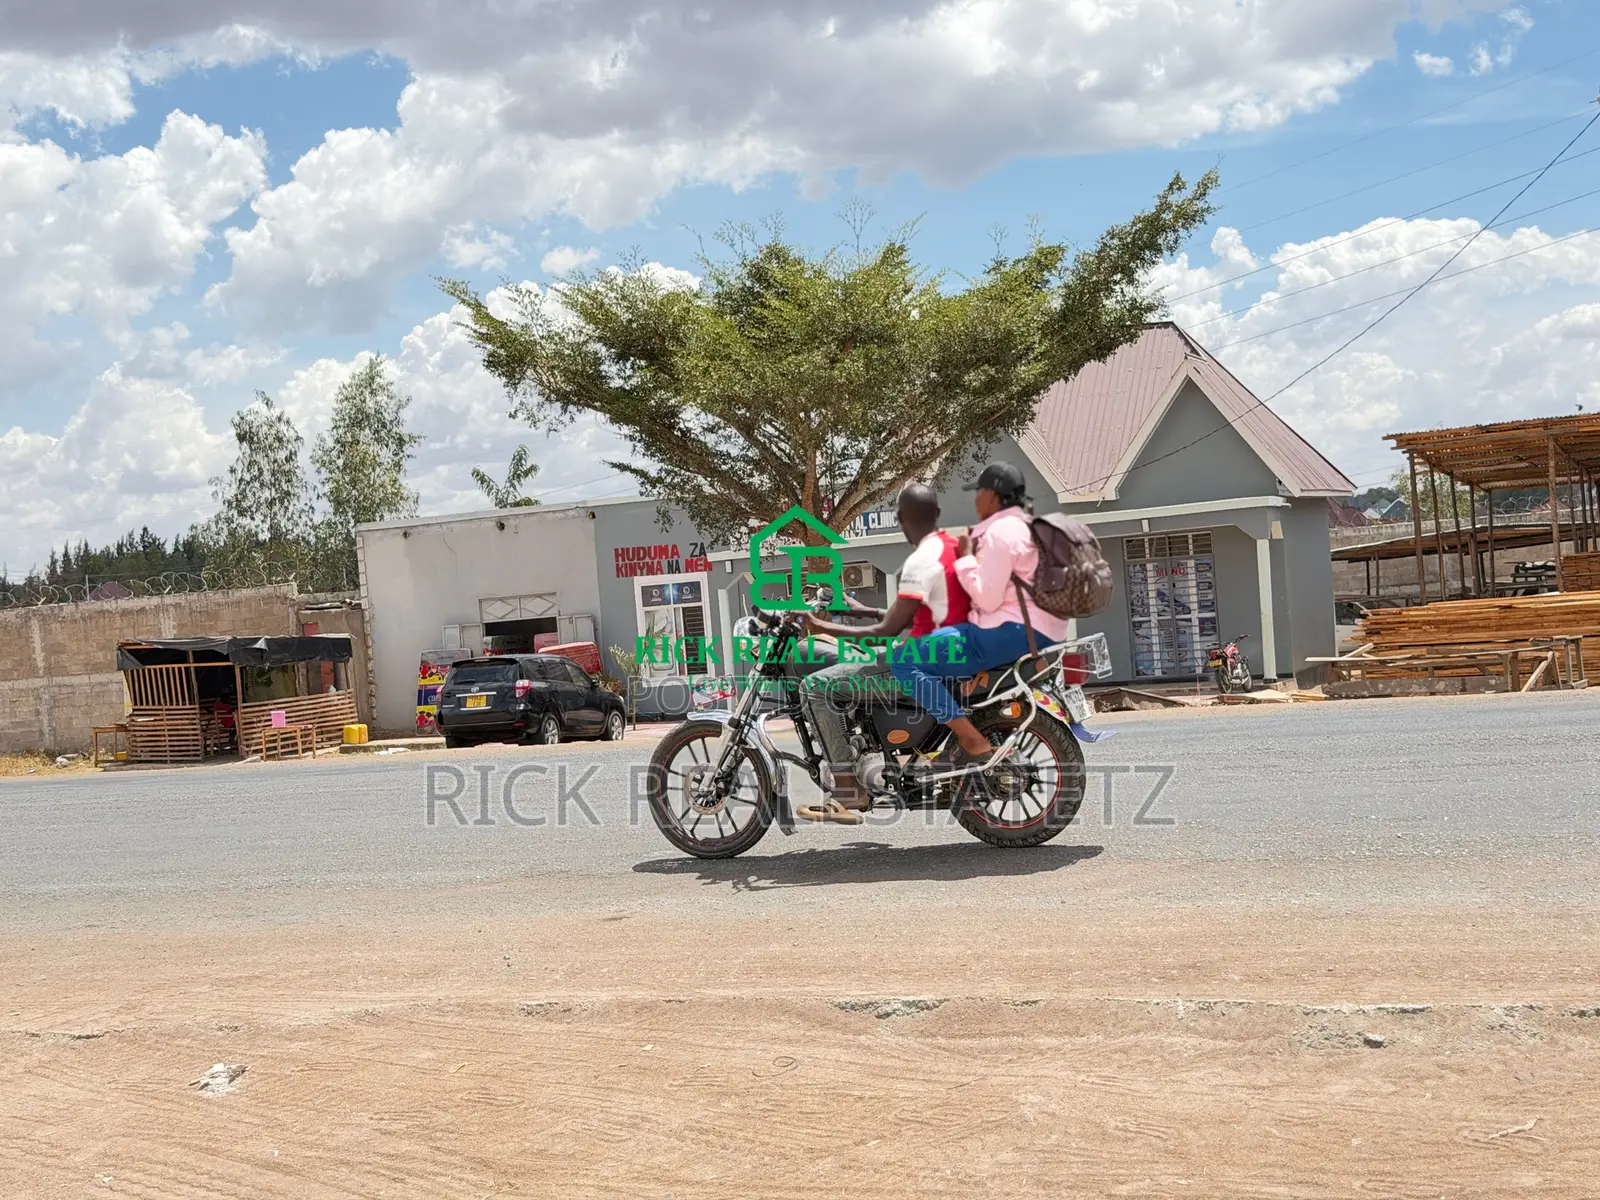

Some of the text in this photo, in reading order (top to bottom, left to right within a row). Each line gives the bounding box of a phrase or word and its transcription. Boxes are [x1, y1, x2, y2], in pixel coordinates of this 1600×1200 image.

[868, 511, 898, 529] CLINIC
[614, 542, 707, 562] HUDUMA ZA
[667, 559, 681, 574] NA
